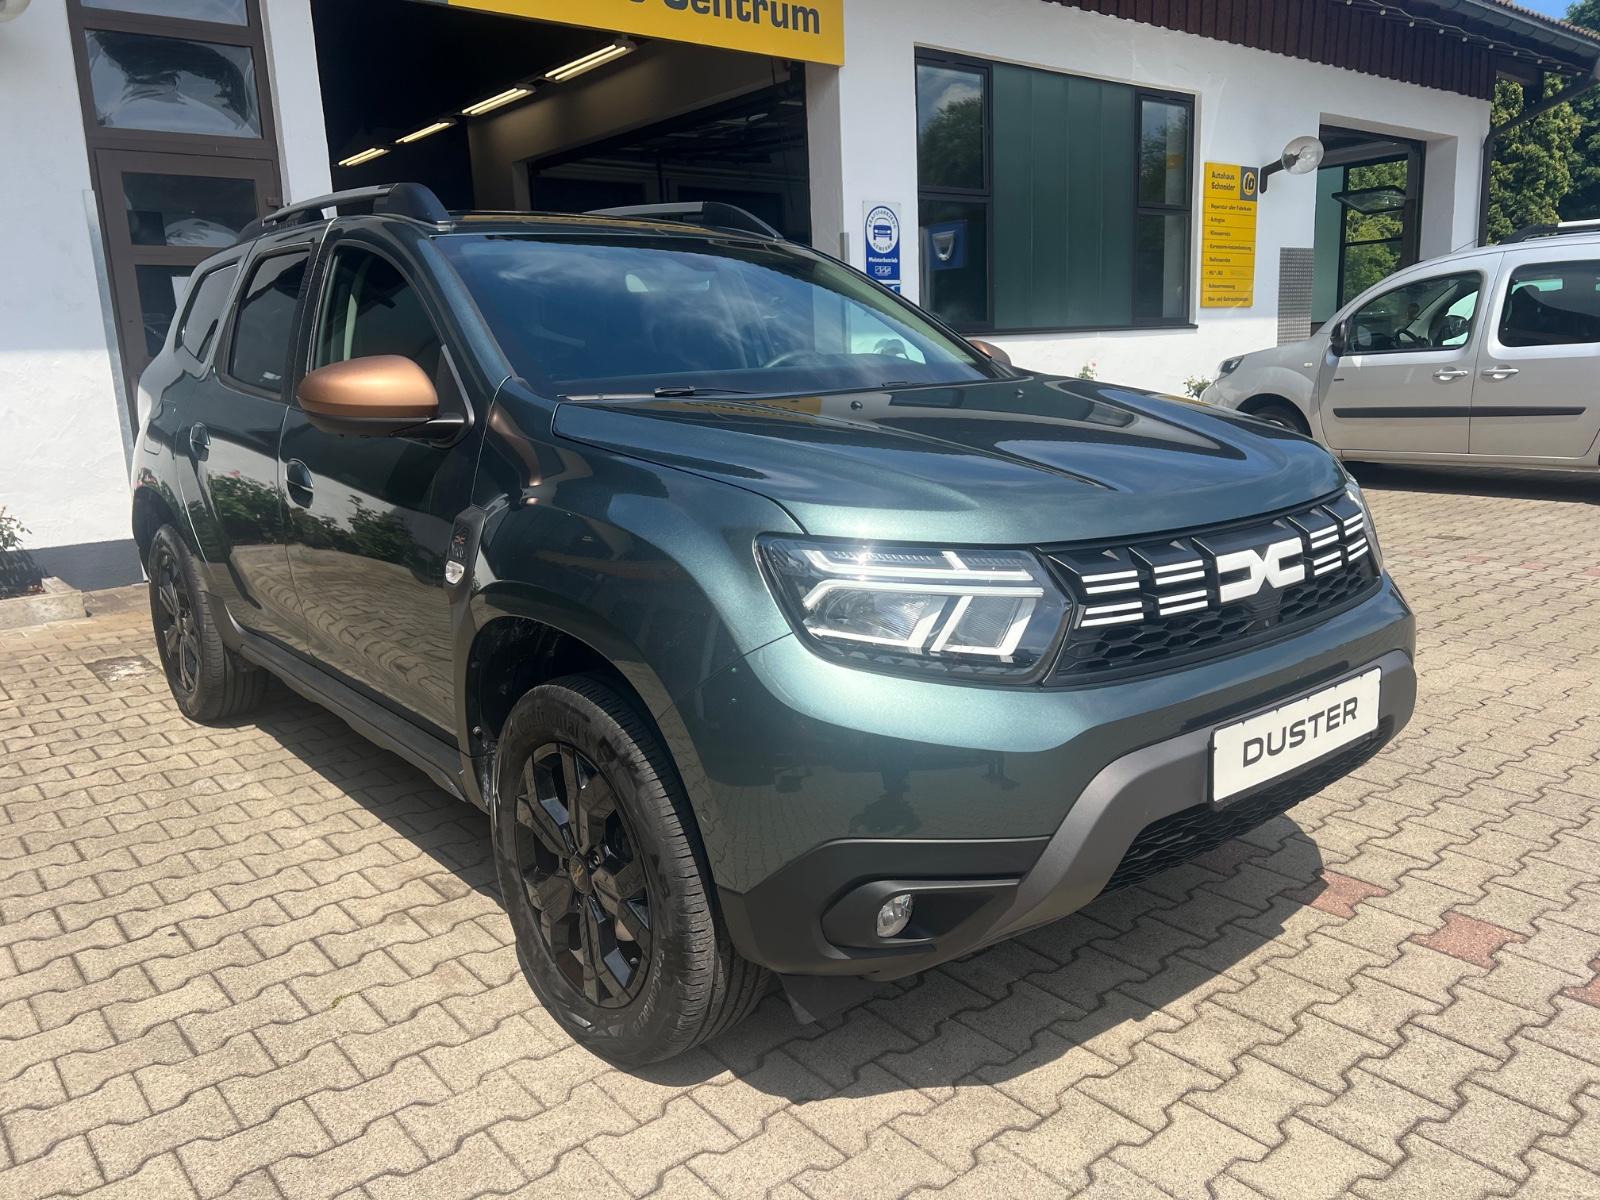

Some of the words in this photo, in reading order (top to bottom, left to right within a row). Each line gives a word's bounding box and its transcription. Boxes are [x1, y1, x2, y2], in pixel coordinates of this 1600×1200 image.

[1211, 171, 1235, 180] Autohaus
[1211, 182, 1236, 191] Schneider
[1242, 696, 1358, 769] DUSTER
